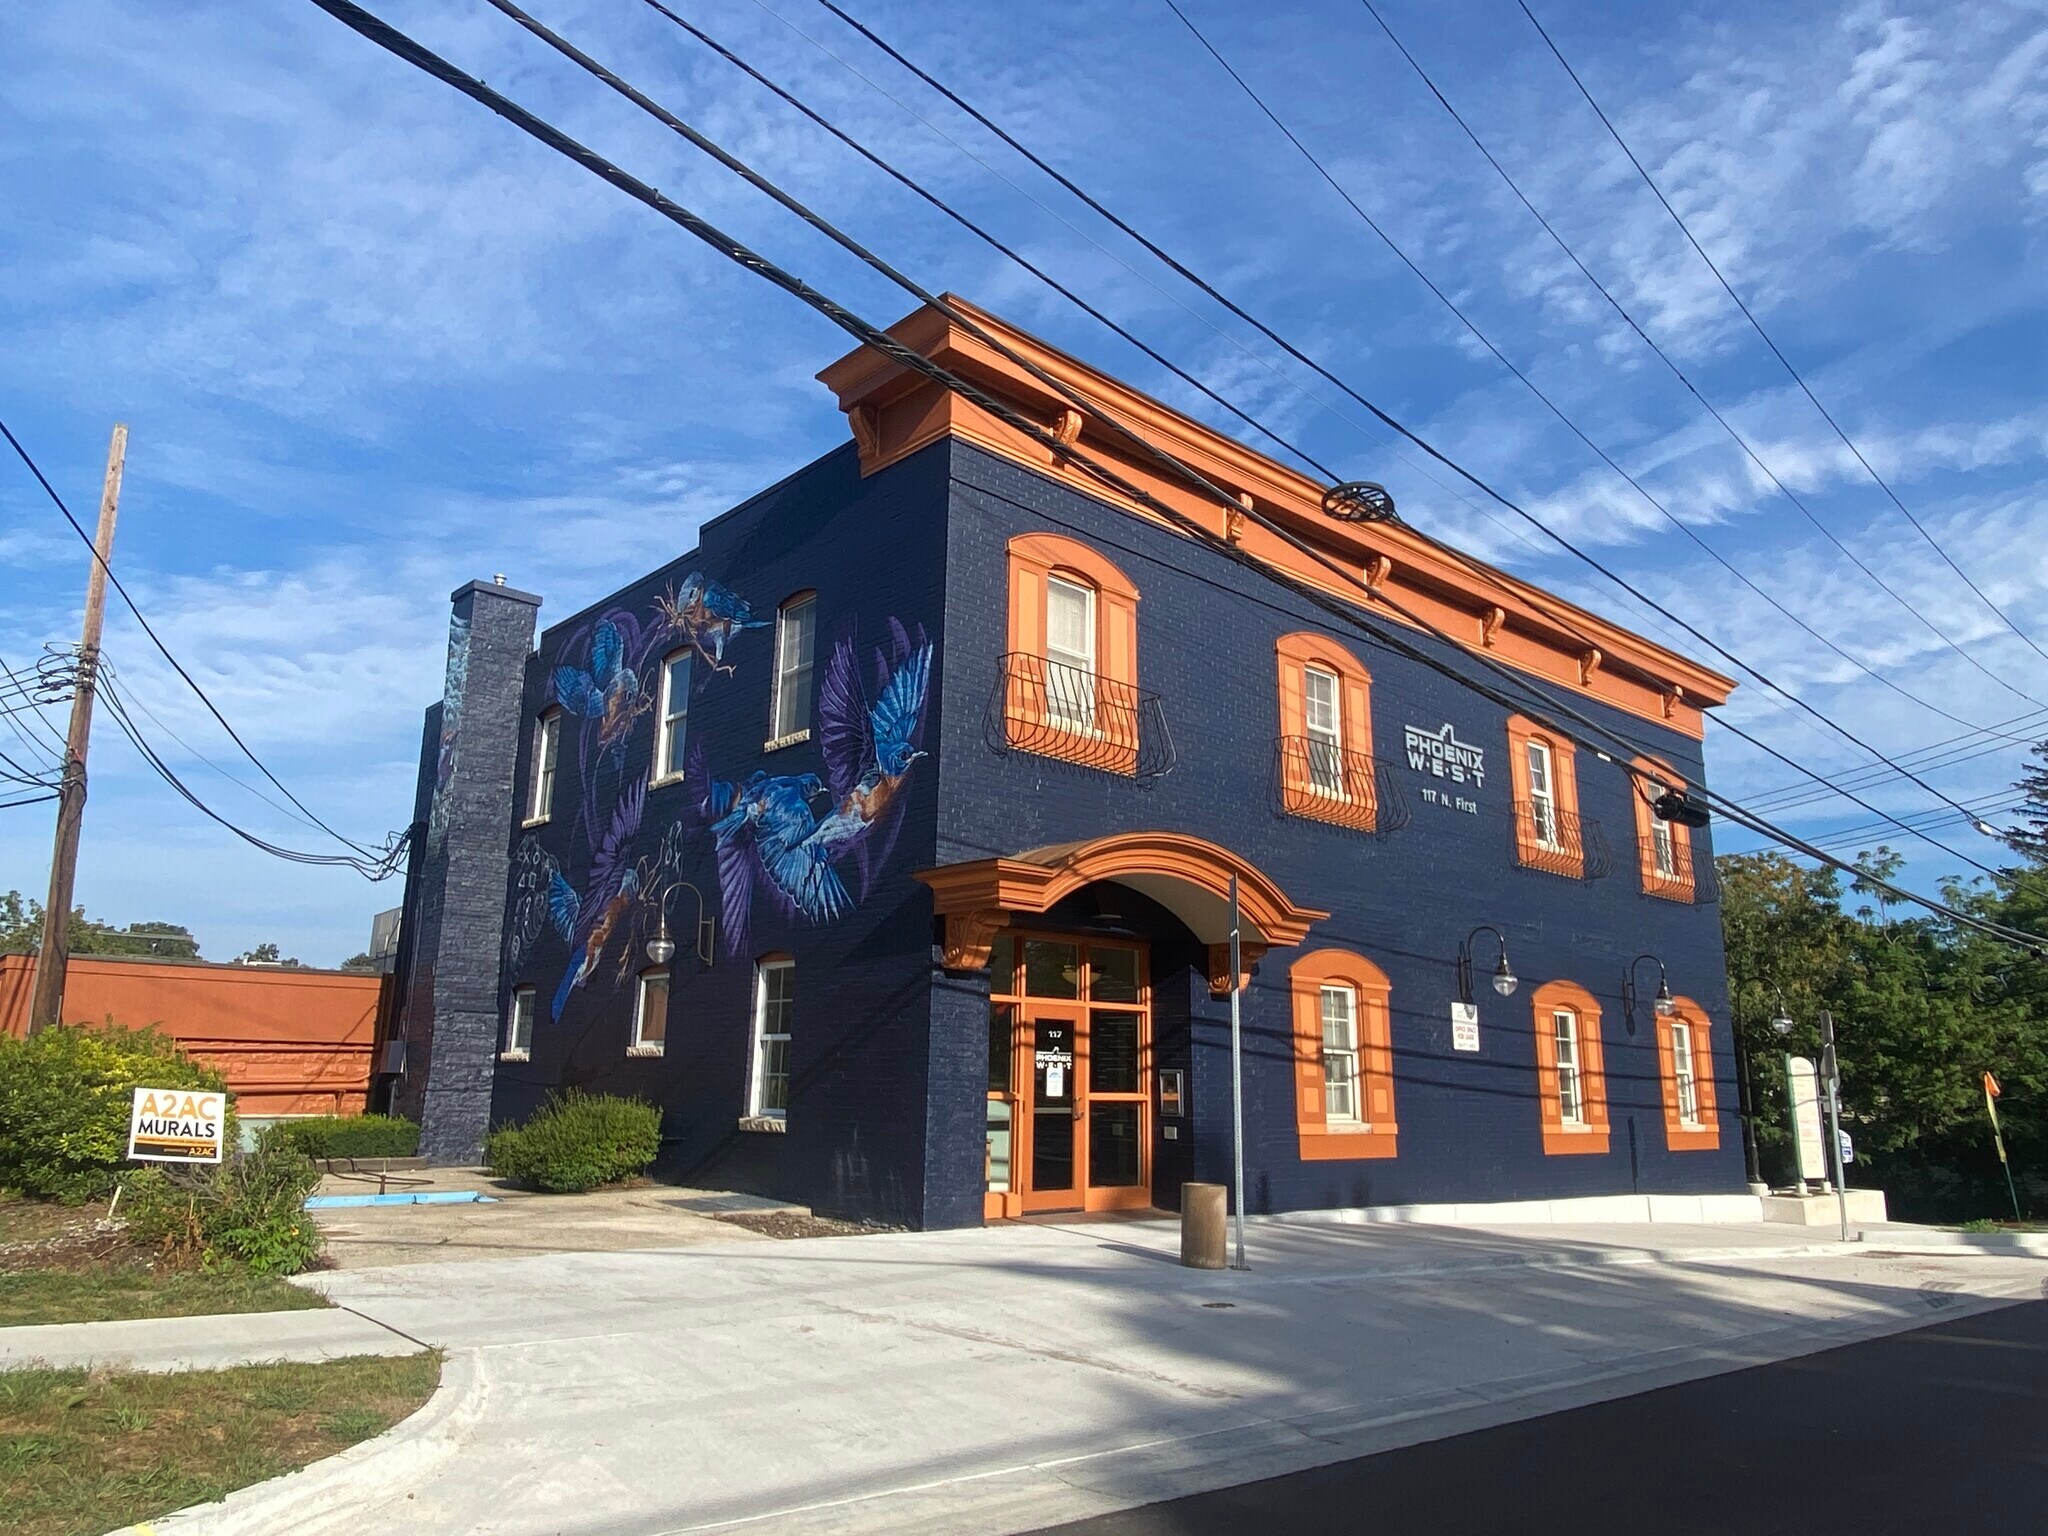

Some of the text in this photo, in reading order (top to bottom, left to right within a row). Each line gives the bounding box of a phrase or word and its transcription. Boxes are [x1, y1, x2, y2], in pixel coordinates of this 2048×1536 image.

[1405, 732, 1484, 772] PHOENIX
[1422, 788, 1478, 814] 117 N. First
[1048, 1030, 1062, 1038] 117
[1036, 1054, 1072, 1062] PHOENIX
[139, 1093, 218, 1121] A2AC
[138, 1118, 215, 1138] MURALS
[188, 1147, 215, 1156] A2AC
